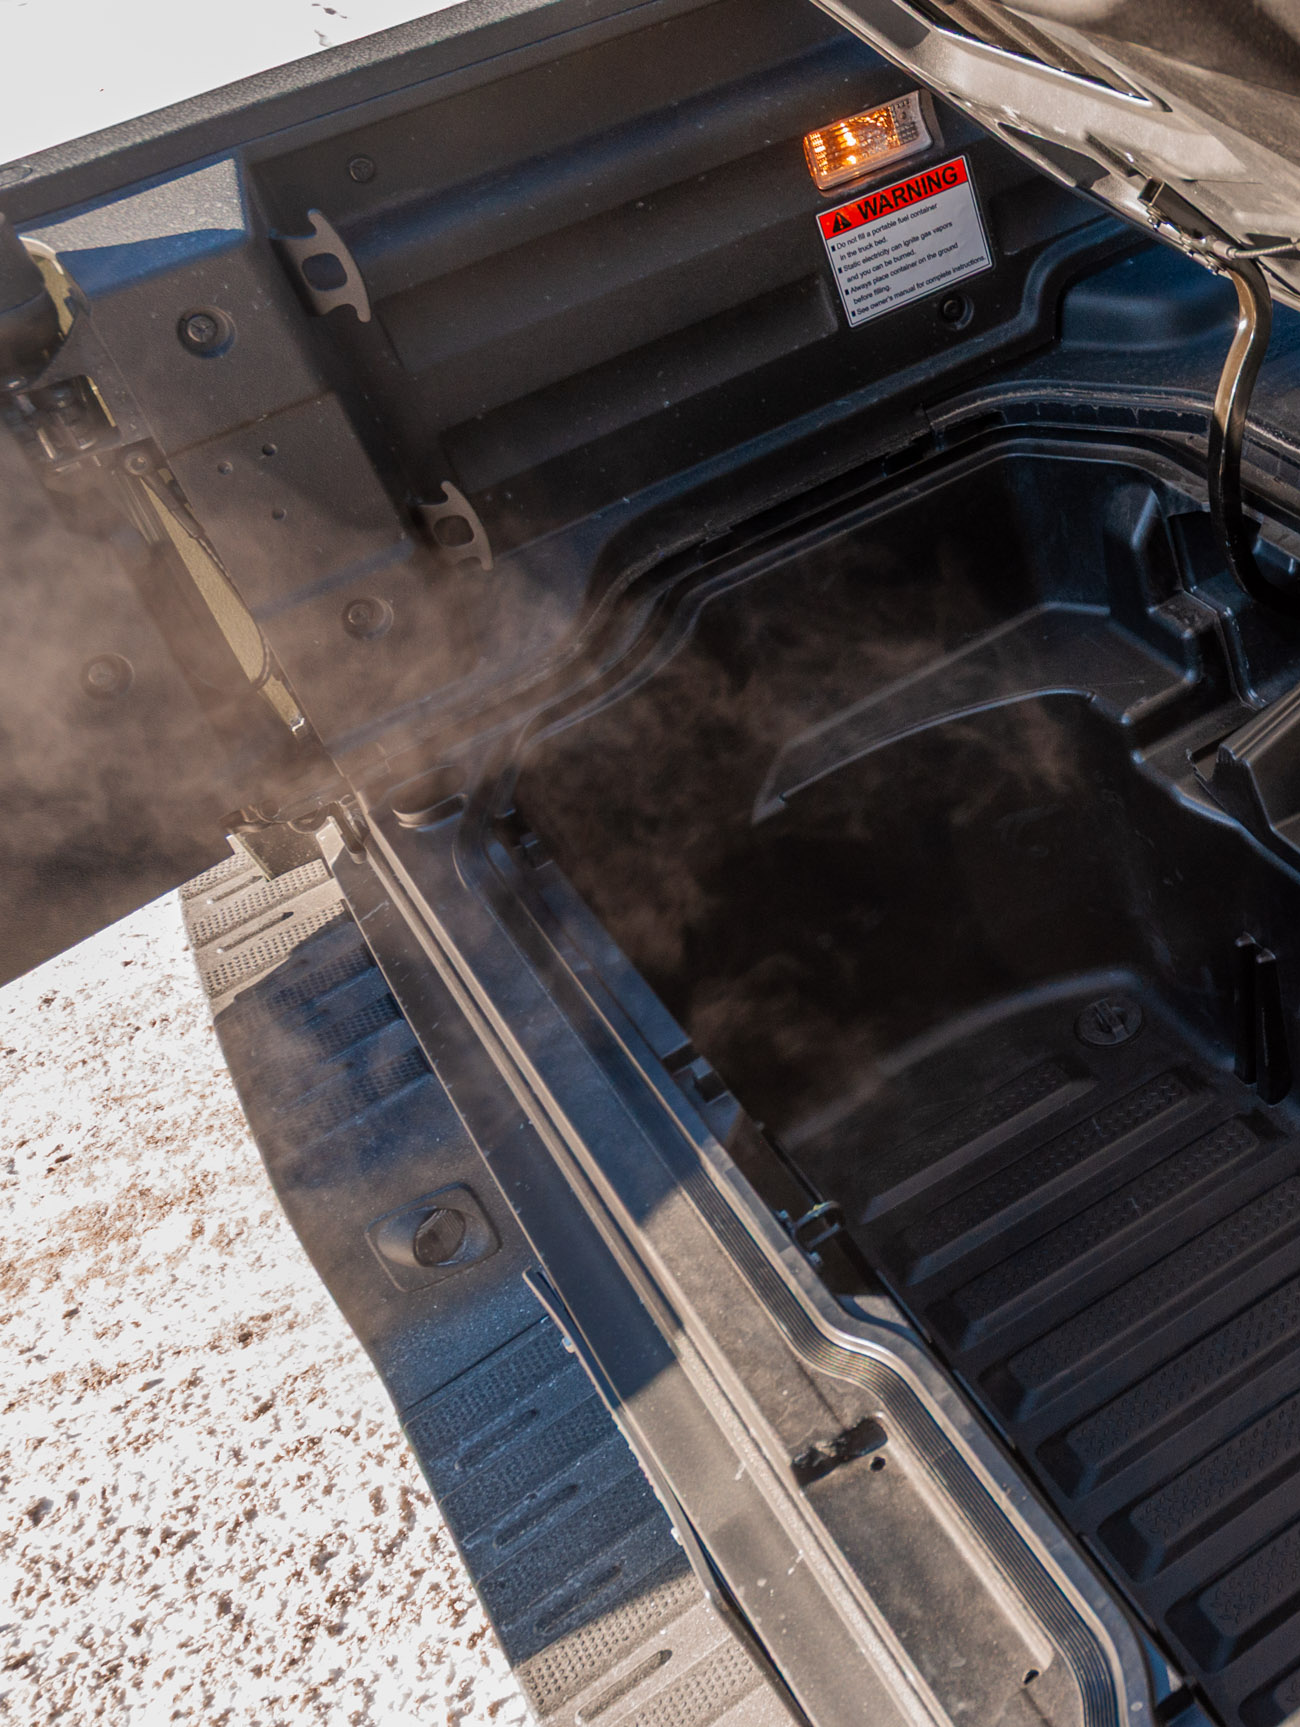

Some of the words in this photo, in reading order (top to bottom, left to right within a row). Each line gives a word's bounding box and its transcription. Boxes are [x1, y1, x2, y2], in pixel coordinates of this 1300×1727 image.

[857, 166, 958, 220] WARNING
[837, 241, 846, 250] Do
[847, 236, 857, 245] not
[857, 232, 865, 240] fill
[872, 220, 896, 236] portable
[898, 213, 909, 224] fuel
[910, 203, 937, 218] container
[843, 260, 861, 271] Static
[862, 248, 889, 263] electricity
[891, 242, 902, 251] can
[903, 235, 919, 247] ignite
[921, 230, 931, 240] gas
[932, 221, 952, 233] vapors
[858, 242, 873, 253] truck
[874, 236, 887, 246] bed.
[847, 272, 859, 282] and
[860, 268, 871, 279] you
[872, 263, 883, 271] can
[893, 248, 916, 262] burned.
[851, 280, 872, 293] Always
[873, 273, 889, 285] place
[890, 260, 917, 276] container
[919, 256, 926, 264] on
[927, 252, 936, 260] the
[938, 242, 958, 257] ground
[857, 306, 869, 315] See
[870, 295, 893, 309] owner's
[894, 284, 916, 298] manual
[926, 270, 951, 285] complete
[952, 255, 985, 273] instructions.
[853, 292, 873, 304] before
[874, 285, 891, 295] filling.
